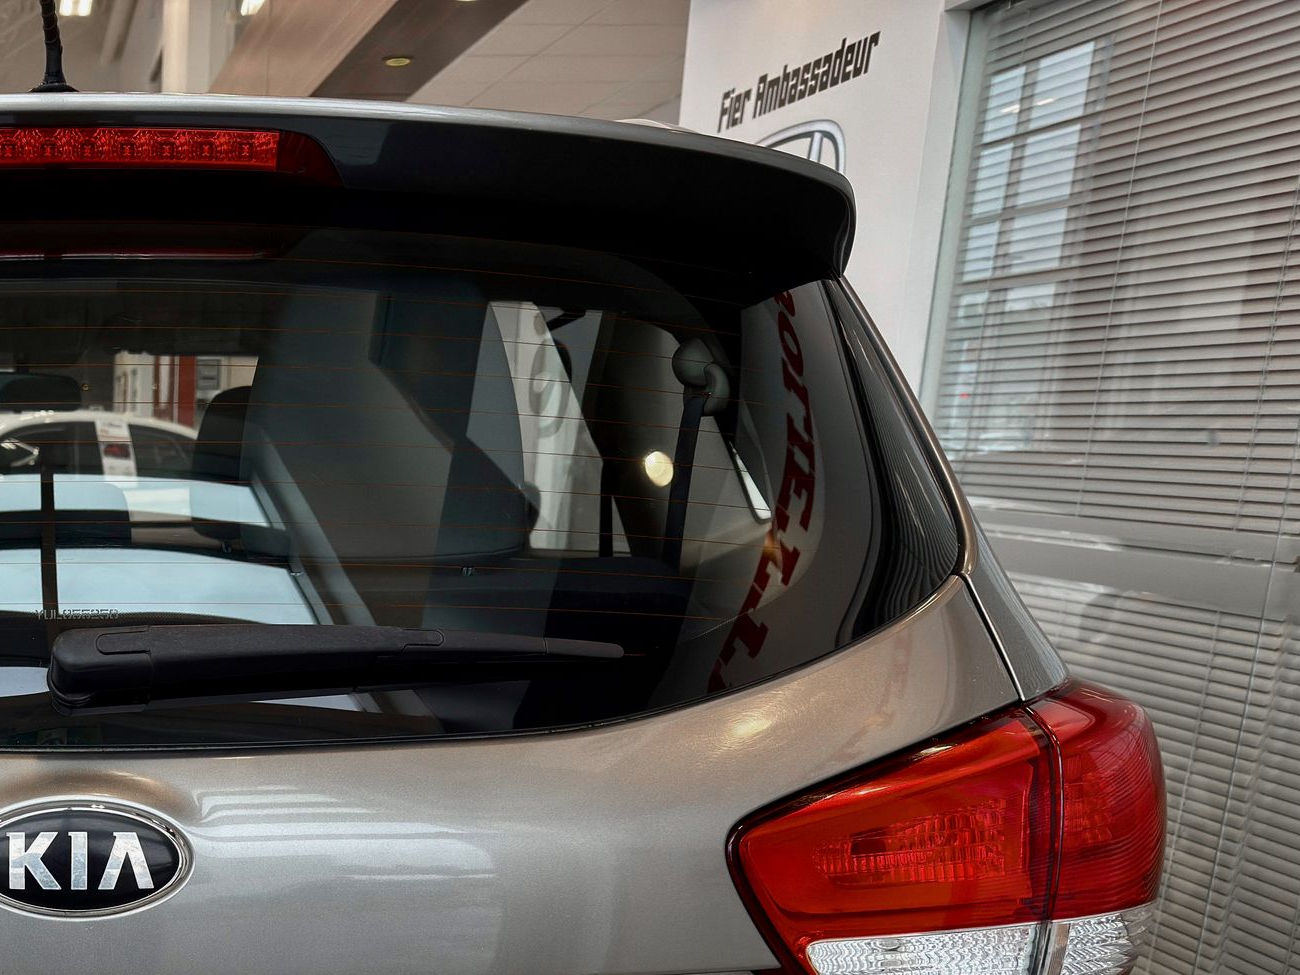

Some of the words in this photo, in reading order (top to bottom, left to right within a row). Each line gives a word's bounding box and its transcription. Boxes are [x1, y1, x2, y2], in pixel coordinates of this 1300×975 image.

[717, 88, 752, 133] Fier
[752, 31, 881, 119] Ambassadeur
[6, 831, 154, 890] KIA
